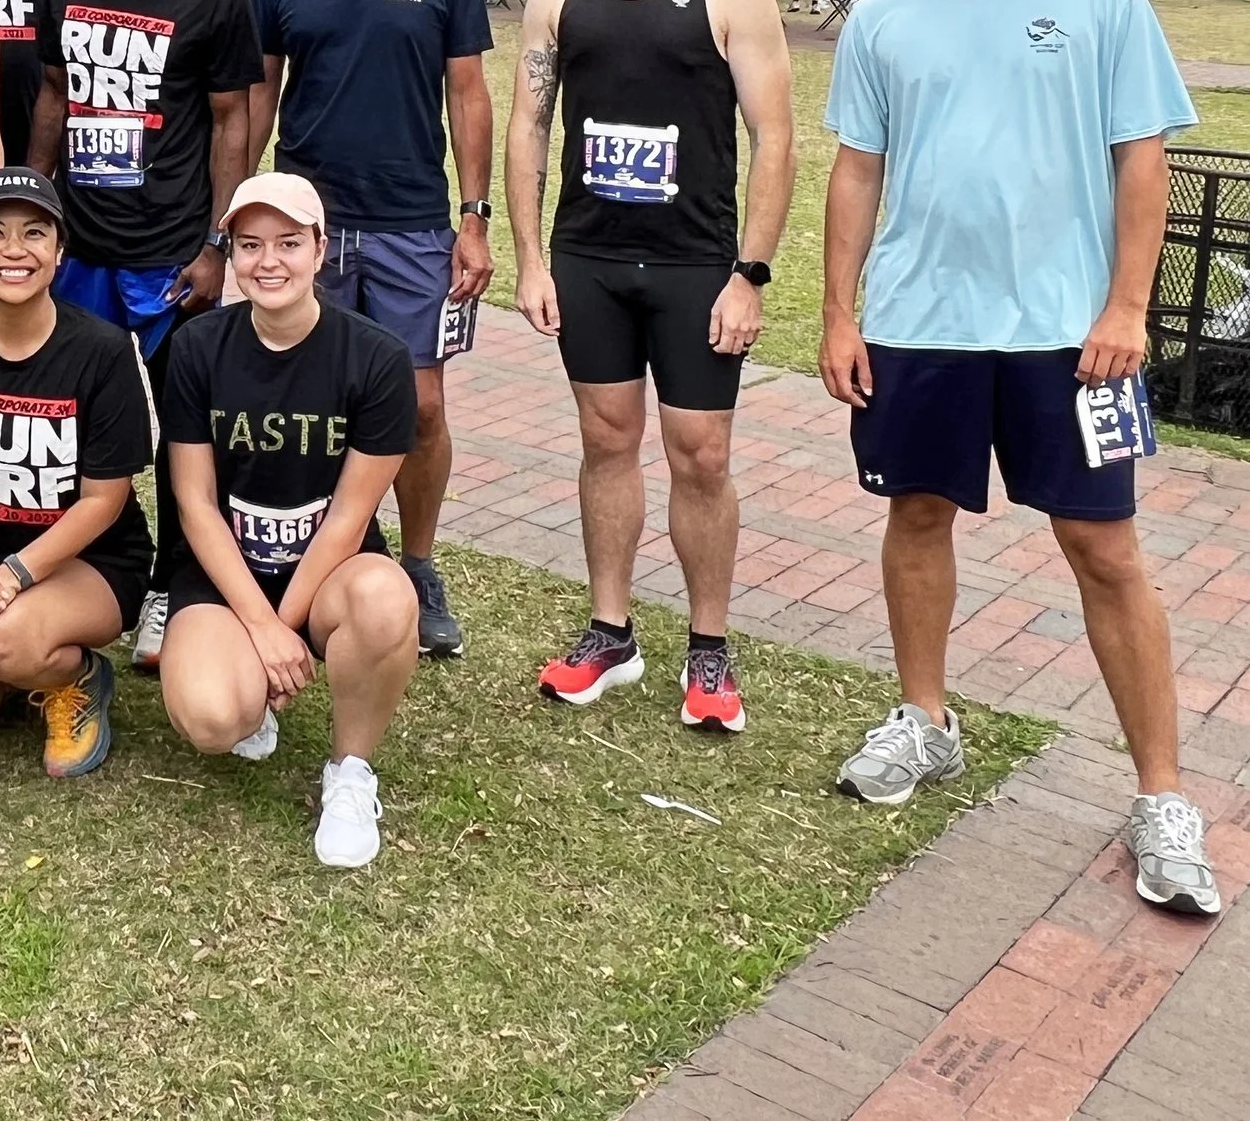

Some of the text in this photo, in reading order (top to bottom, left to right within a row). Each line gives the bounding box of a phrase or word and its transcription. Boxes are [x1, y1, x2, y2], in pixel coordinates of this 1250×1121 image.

[61, 20, 171, 73] RUN
[76, 129, 128, 155] 1369
[595, 136, 662, 168] 1372
[1088, 380, 1123, 445] 136
[245, 514, 313, 545] 1366
